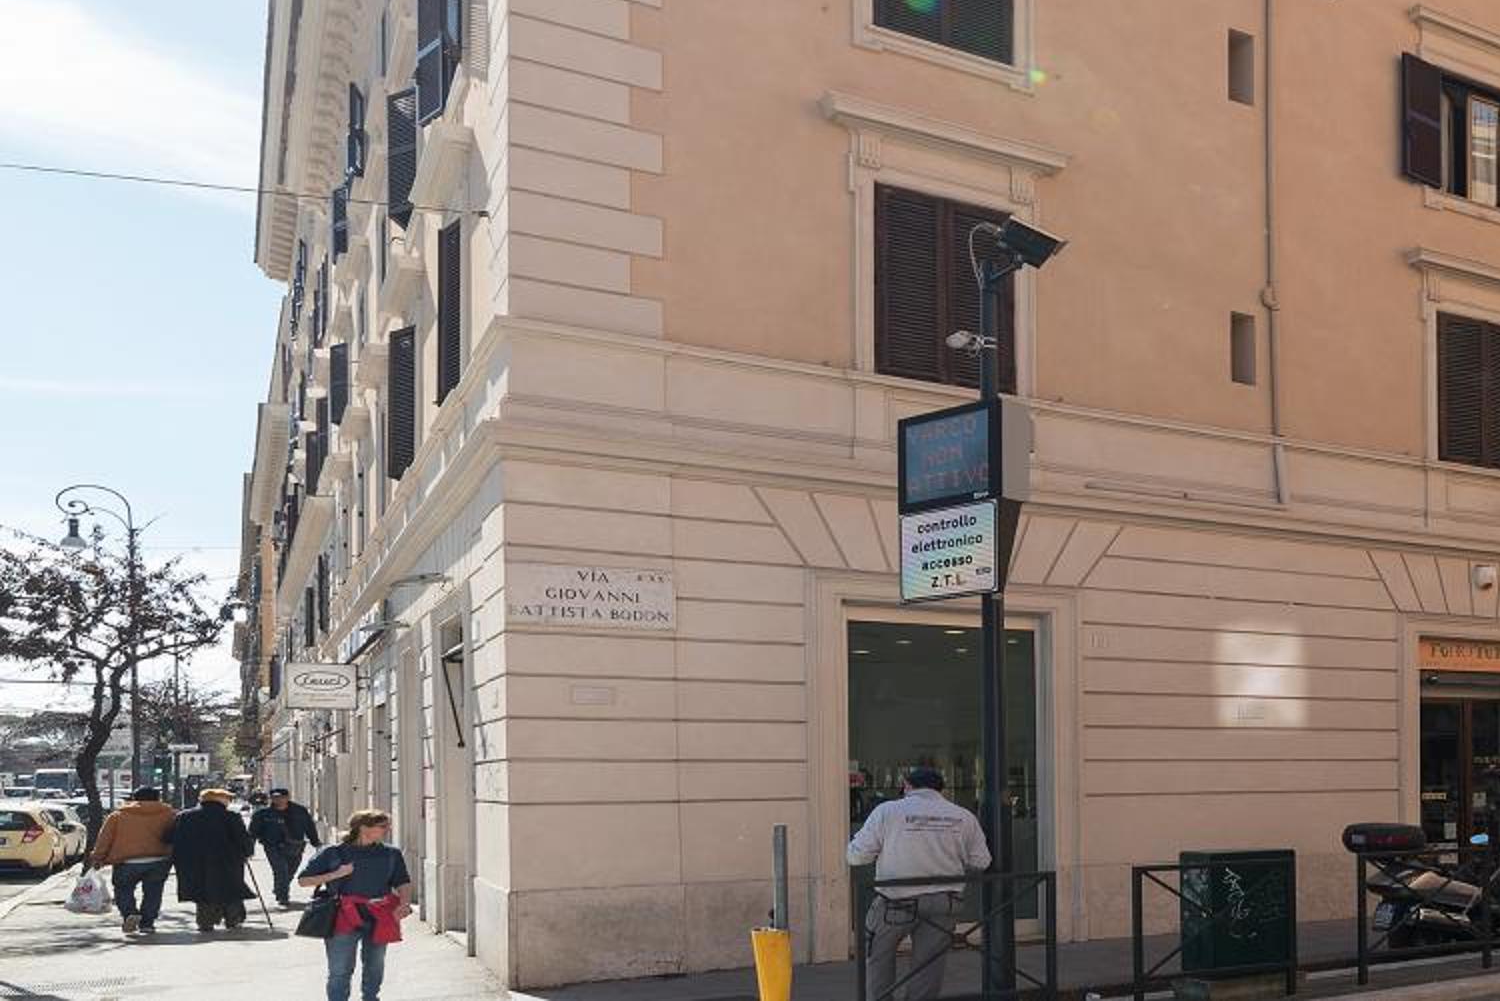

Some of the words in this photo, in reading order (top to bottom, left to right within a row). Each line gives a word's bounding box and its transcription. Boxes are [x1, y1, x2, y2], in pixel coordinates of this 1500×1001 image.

[917, 515, 977, 534] controllo
[911, 534, 983, 554] elettronico
[921, 555, 973, 571] accesso
[577, 570, 609, 583] VIA
[545, 588, 640, 604] GIOVANNI
